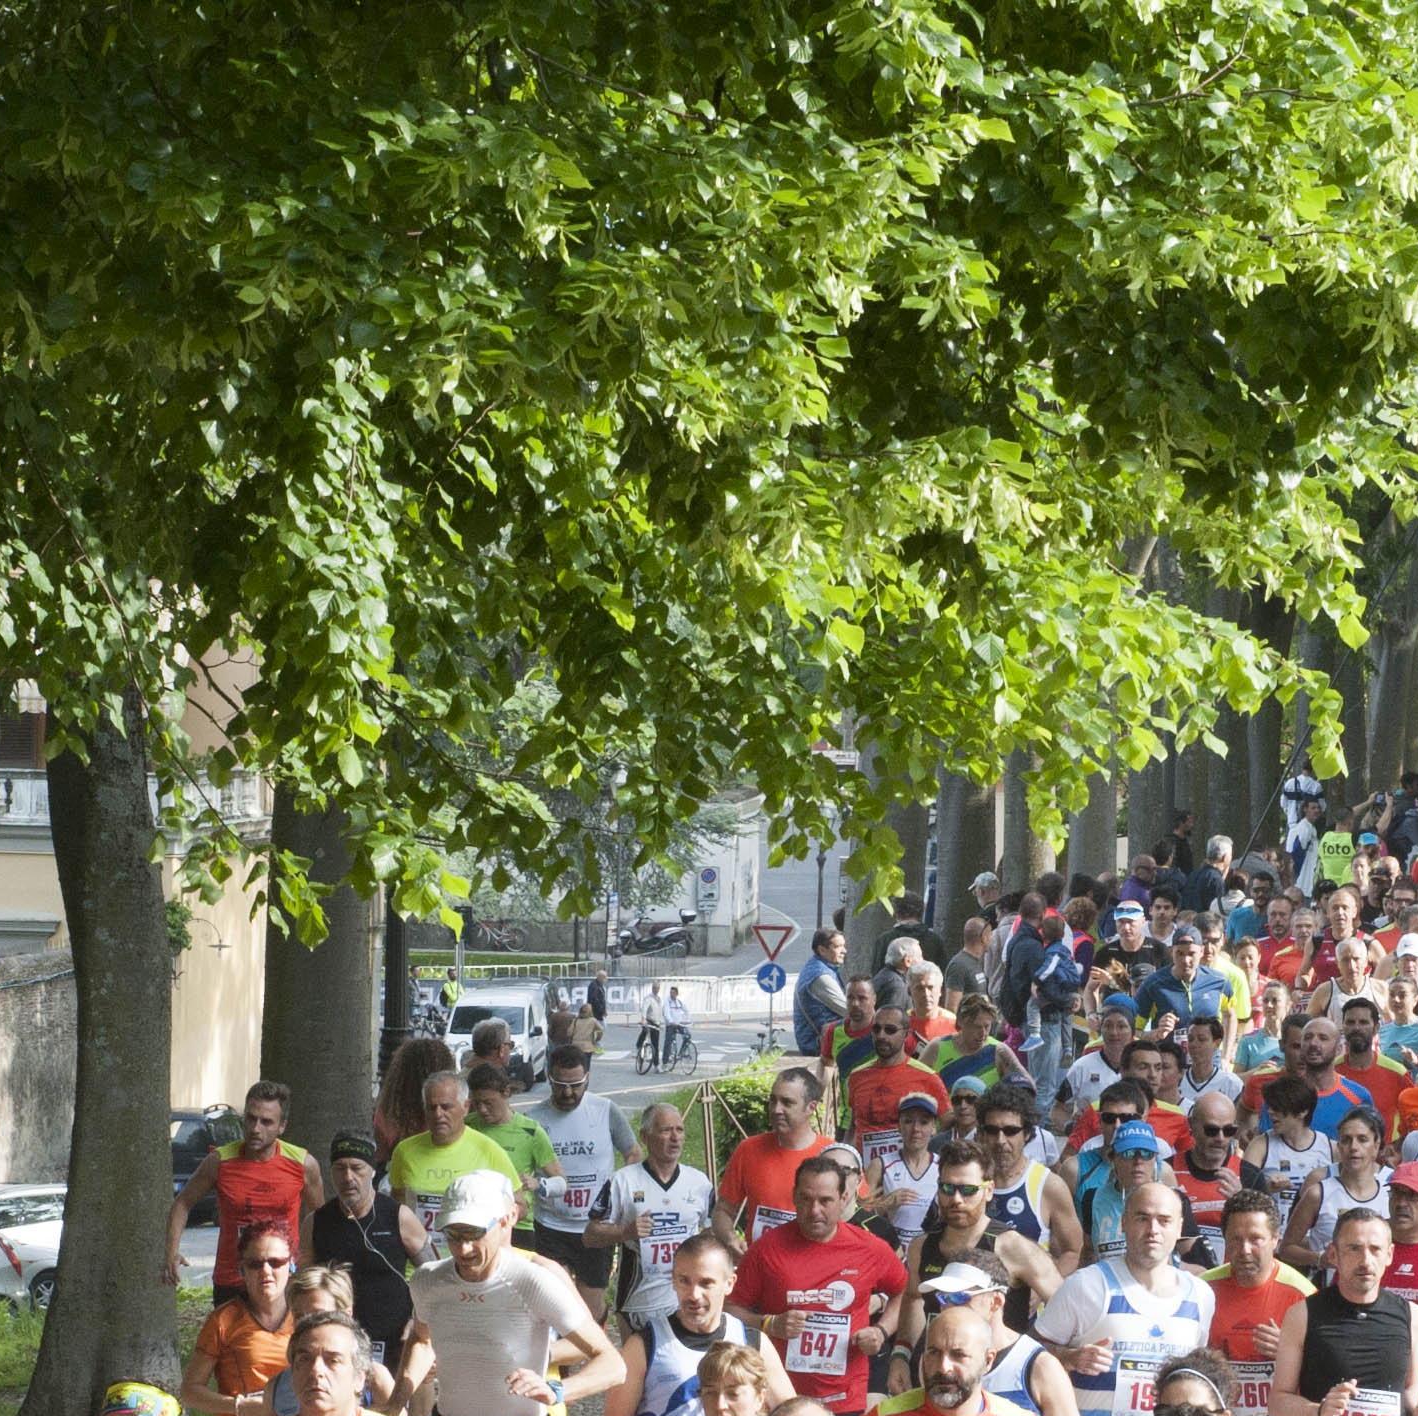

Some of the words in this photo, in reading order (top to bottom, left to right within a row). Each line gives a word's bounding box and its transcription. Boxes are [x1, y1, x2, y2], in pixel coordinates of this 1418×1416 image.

[1322, 842, 1352, 855] foto
[1119, 1127, 1152, 1139] ITALIA
[563, 1189, 591, 1207] 487
[800, 1331, 839, 1357] 647
